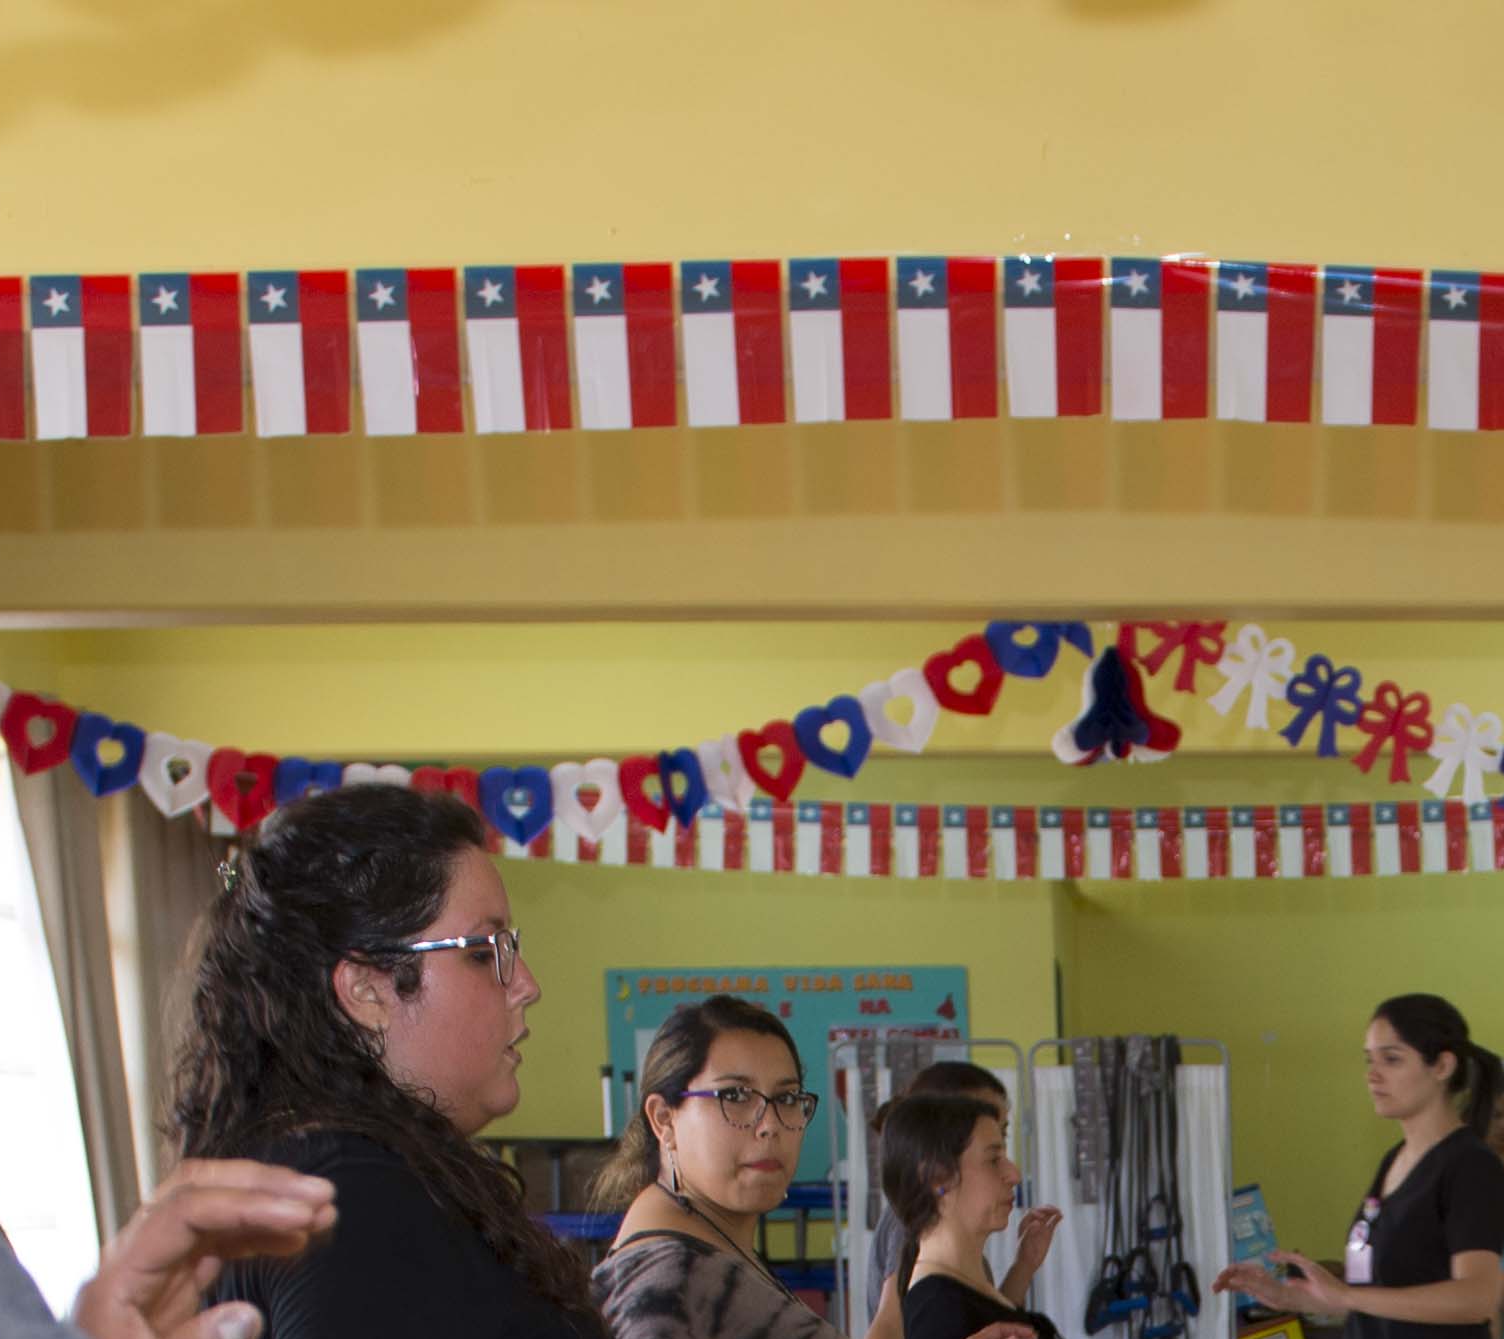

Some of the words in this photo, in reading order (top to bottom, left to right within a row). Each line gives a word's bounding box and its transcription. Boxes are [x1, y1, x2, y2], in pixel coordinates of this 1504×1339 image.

[638, 976, 769, 994] PROGRAMA
[783, 975, 844, 992] VIDA
[853, 974, 913, 992] SANA
